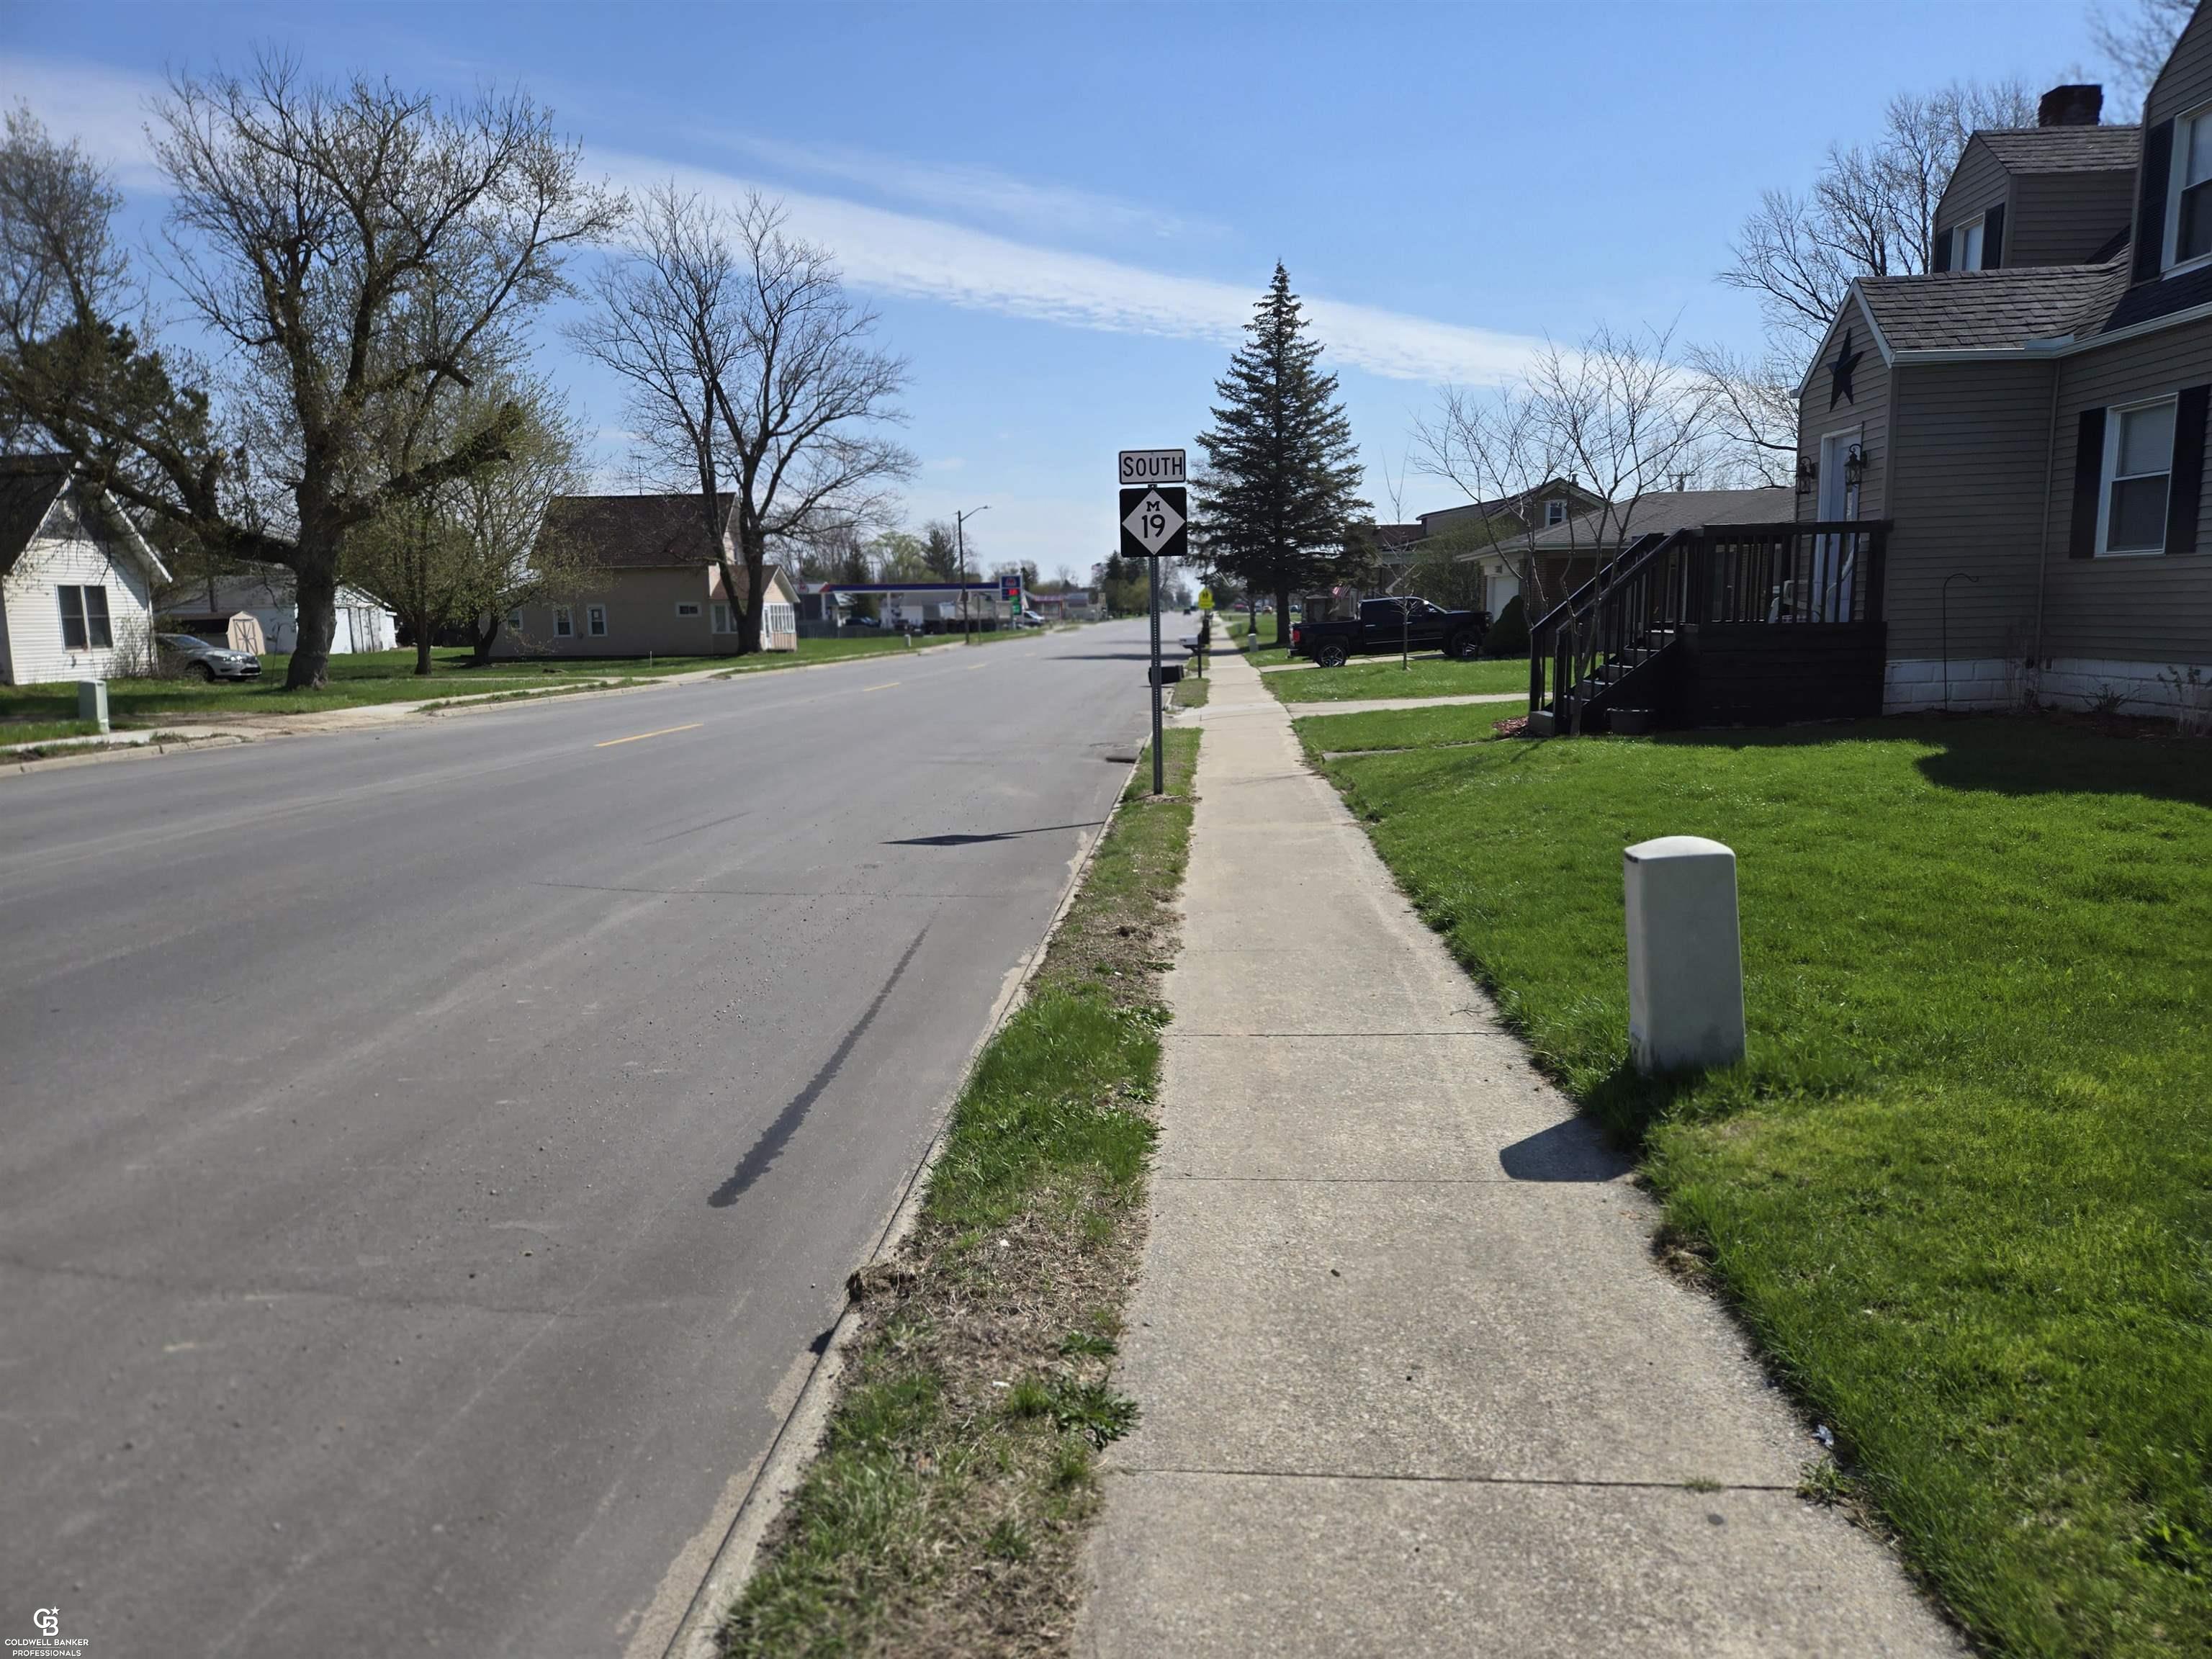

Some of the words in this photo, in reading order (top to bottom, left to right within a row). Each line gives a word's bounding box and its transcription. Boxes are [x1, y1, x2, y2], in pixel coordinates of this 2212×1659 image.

[1123, 457, 1182, 477] SOUTH
[1146, 501, 1160, 511] M
[1141, 514, 1165, 539] 19
